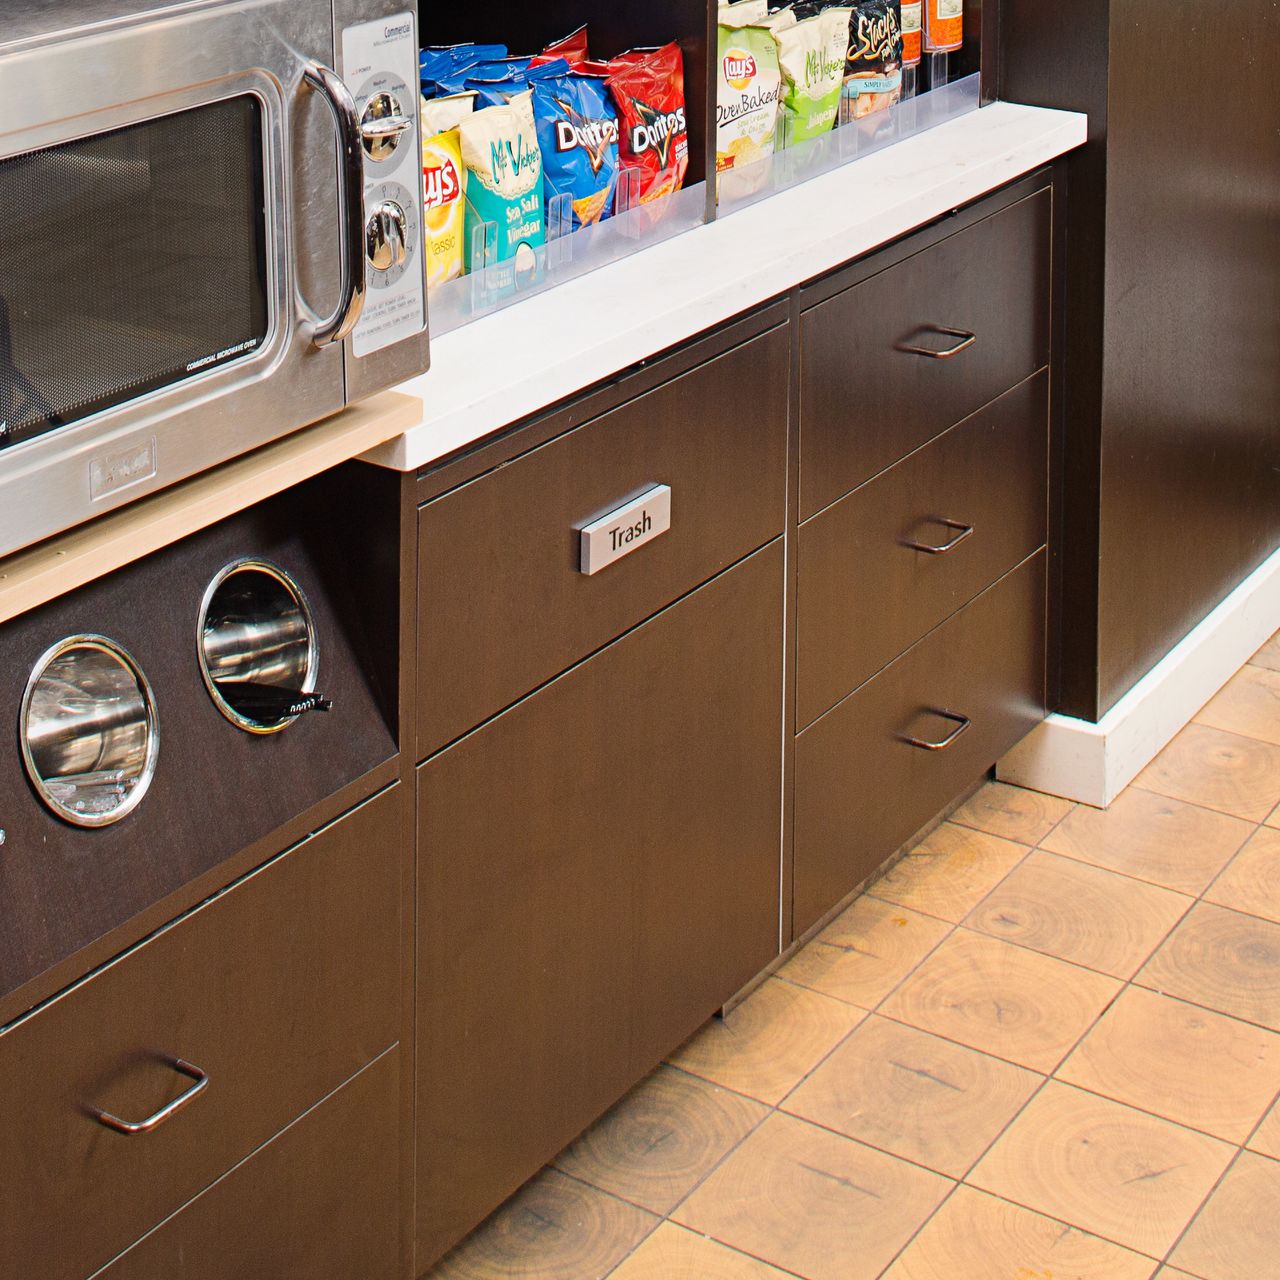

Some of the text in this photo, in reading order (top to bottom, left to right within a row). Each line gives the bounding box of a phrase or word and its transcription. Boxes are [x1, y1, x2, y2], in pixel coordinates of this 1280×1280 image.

[847, 6, 898, 60] Stacy's
[723, 56, 757, 81] Lay's
[557, 118, 619, 152] Doritos
[632, 106, 687, 154] Doritos
[506, 195, 539, 223] Sea Salt
[506, 219, 541, 245] Vinegar
[186, 353, 217, 372] COMMERCIAL
[243, 338, 257, 349] OVEN
[608, 510, 652, 551] Trash
